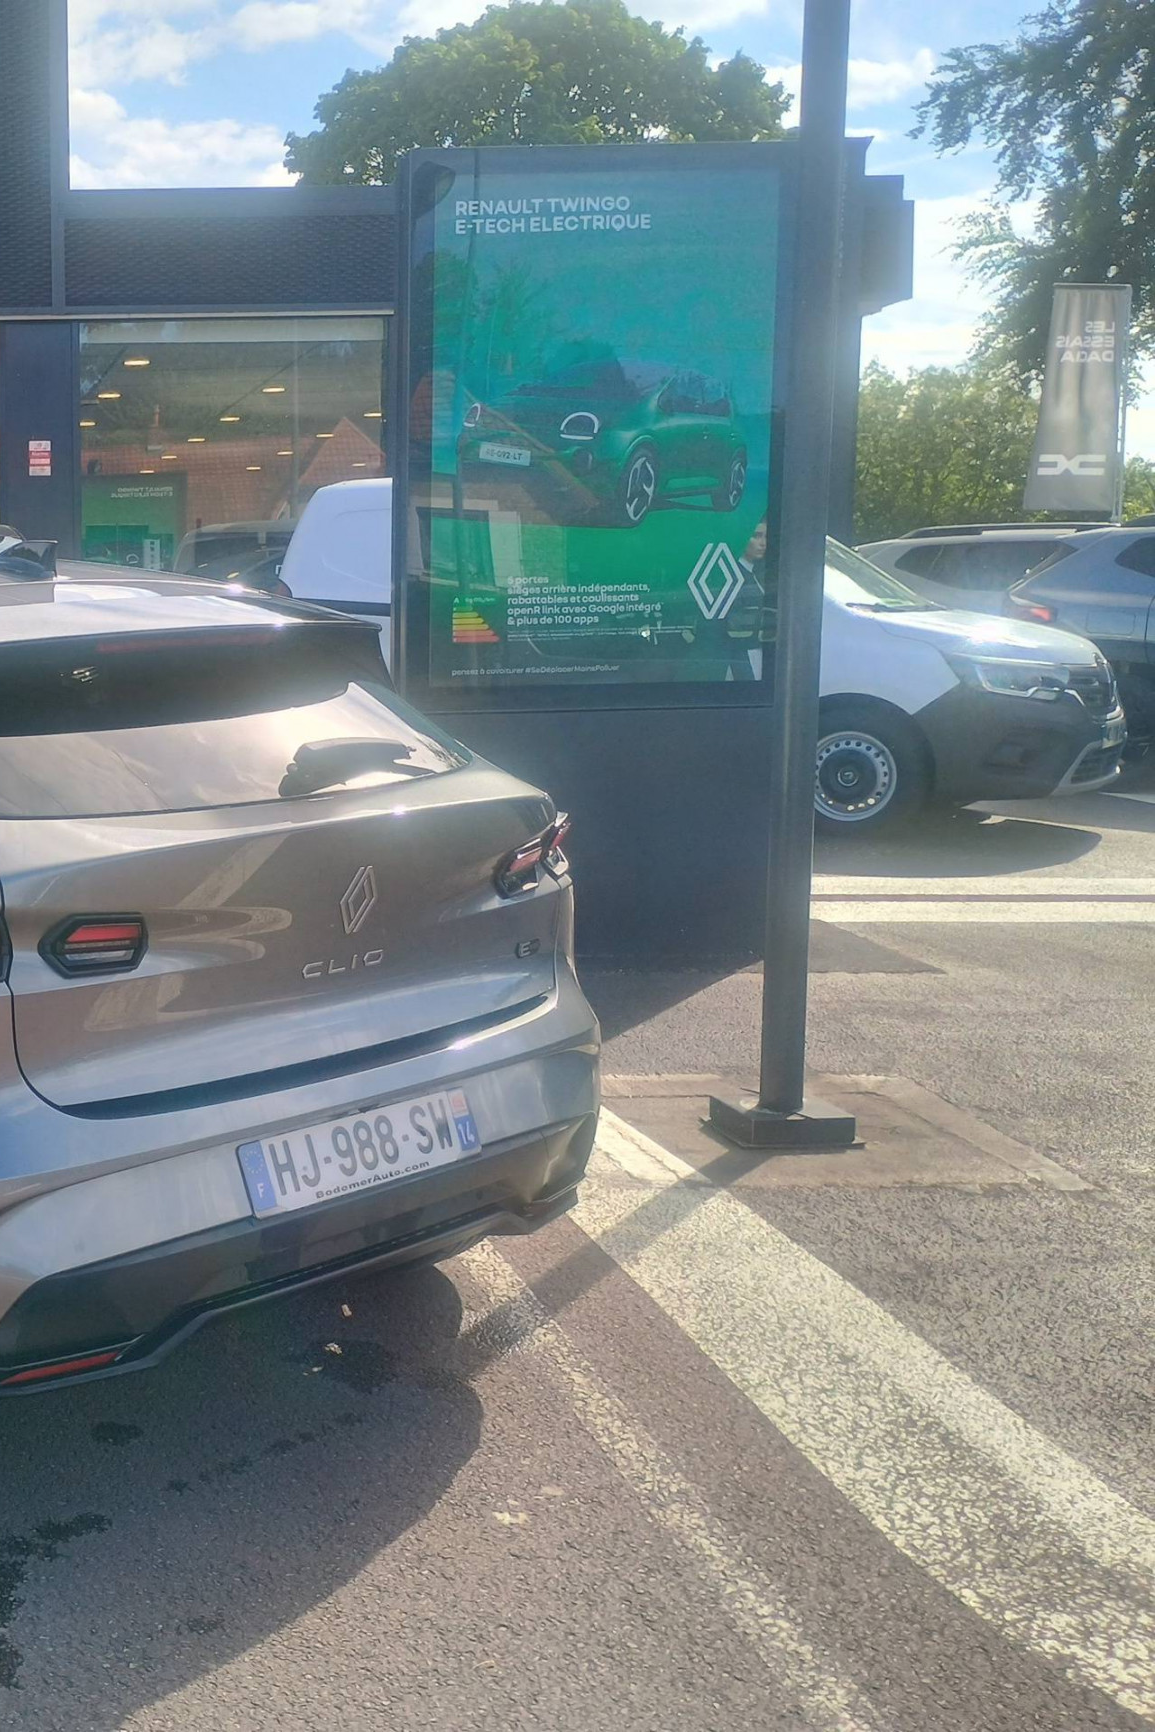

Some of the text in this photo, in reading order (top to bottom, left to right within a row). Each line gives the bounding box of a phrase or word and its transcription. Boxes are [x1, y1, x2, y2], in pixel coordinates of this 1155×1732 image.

[455, 196, 630, 216] RENAULT TWINGO
[455, 213, 651, 234] E-TECH ELECTRIQUE
[570, 595, 581, 603] et
[542, 604, 561, 614] link
[562, 606, 587, 614] avec
[588, 603, 625, 616] Google
[517, 616, 539, 627] plus
[540, 615, 552, 624] de
[554, 616, 572, 624] 100
[573, 616, 599, 626] apps
[302, 949, 384, 979] CLIO
[257, 1099, 476, 1198] F HJ-988-SW 14
